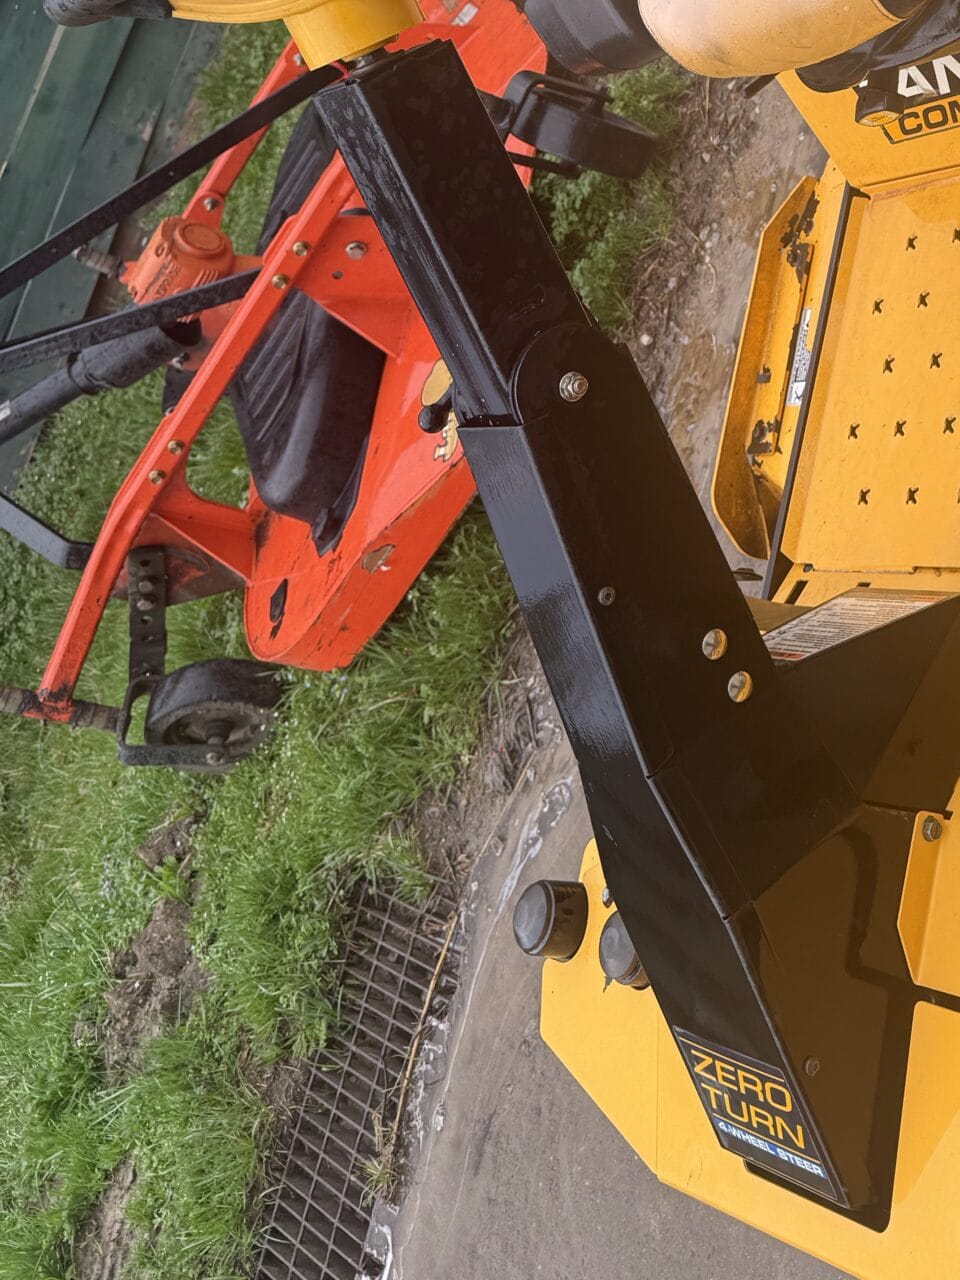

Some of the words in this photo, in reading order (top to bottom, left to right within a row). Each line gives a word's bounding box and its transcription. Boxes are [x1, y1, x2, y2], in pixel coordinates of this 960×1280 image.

[691, 1049, 793, 1113] ZERO
[701, 1082, 806, 1150] TURN
[718, 1121, 776, 1155] 4-WHEEL
[776, 1147, 827, 1180] STEER
